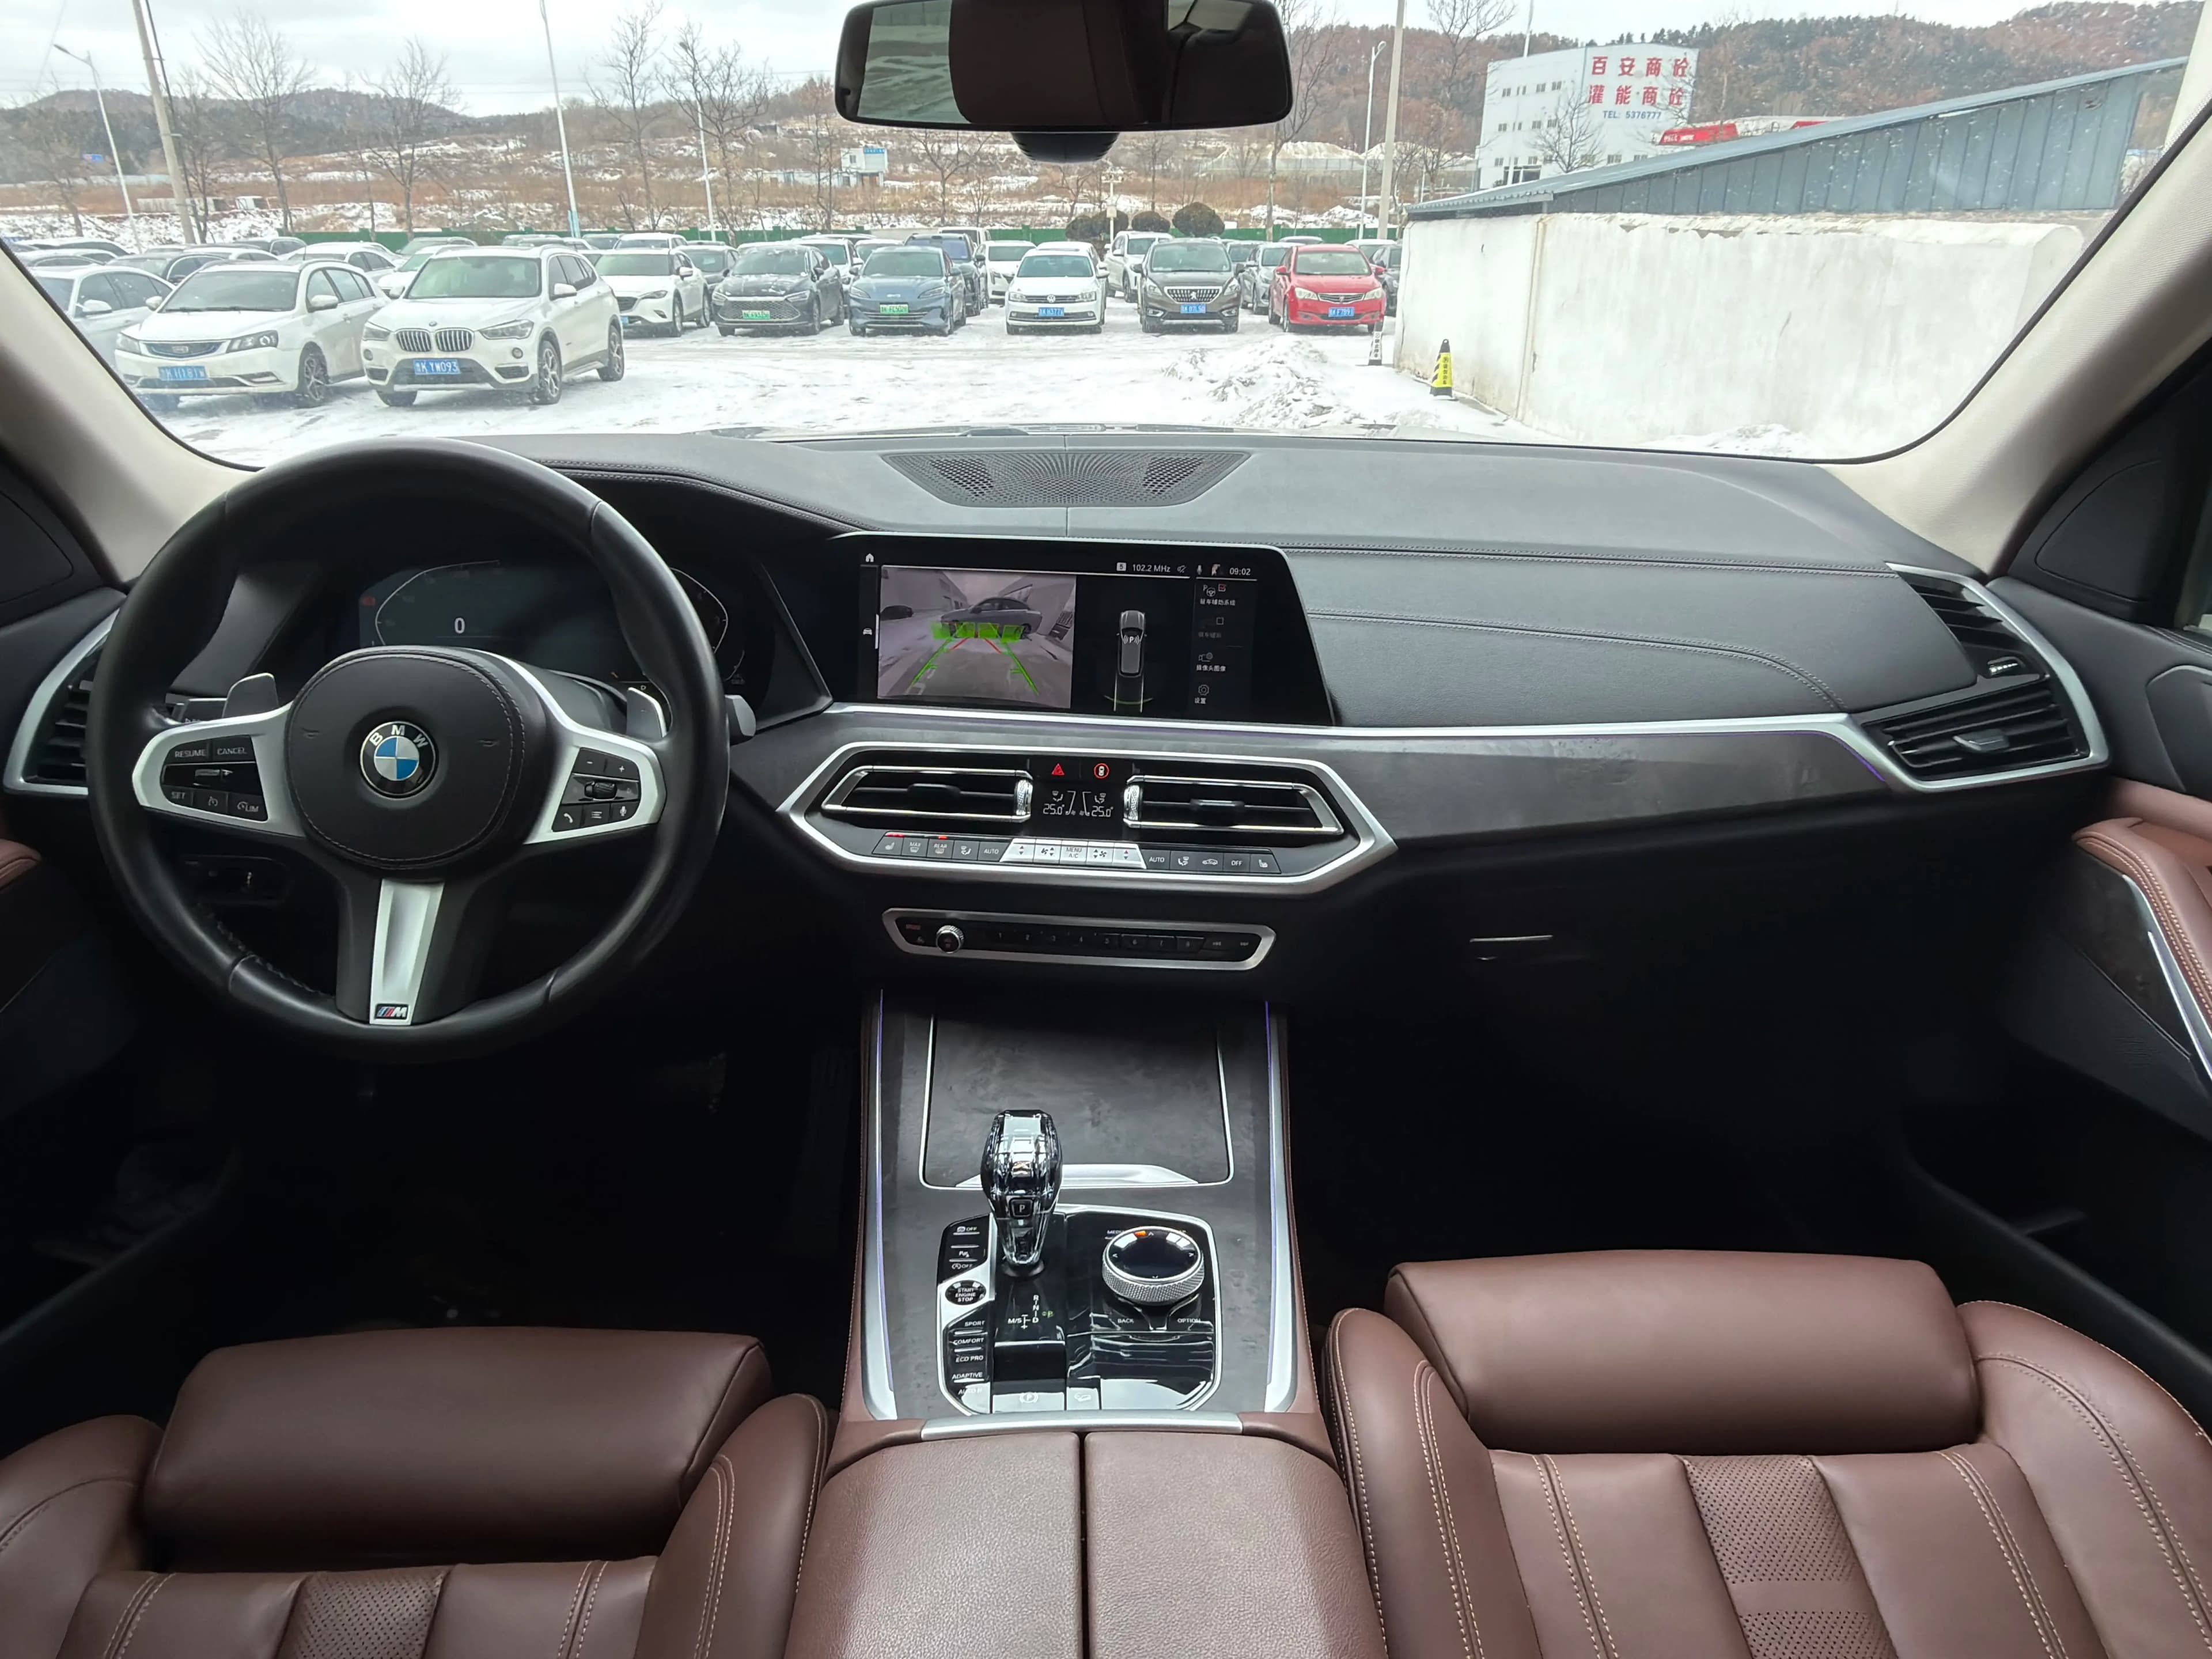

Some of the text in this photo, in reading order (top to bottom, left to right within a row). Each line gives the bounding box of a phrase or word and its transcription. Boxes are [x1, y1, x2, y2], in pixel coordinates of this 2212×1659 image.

[1592, 56, 1688, 77] 百安商砼
[1229, 567, 1251, 575] 09:02
[454, 618, 465, 634] 0
[369, 725, 429, 748] BMW
[175, 749, 206, 757] RESUME
[217, 747, 247, 755] CANCEL
[171, 791, 185, 800] SET
